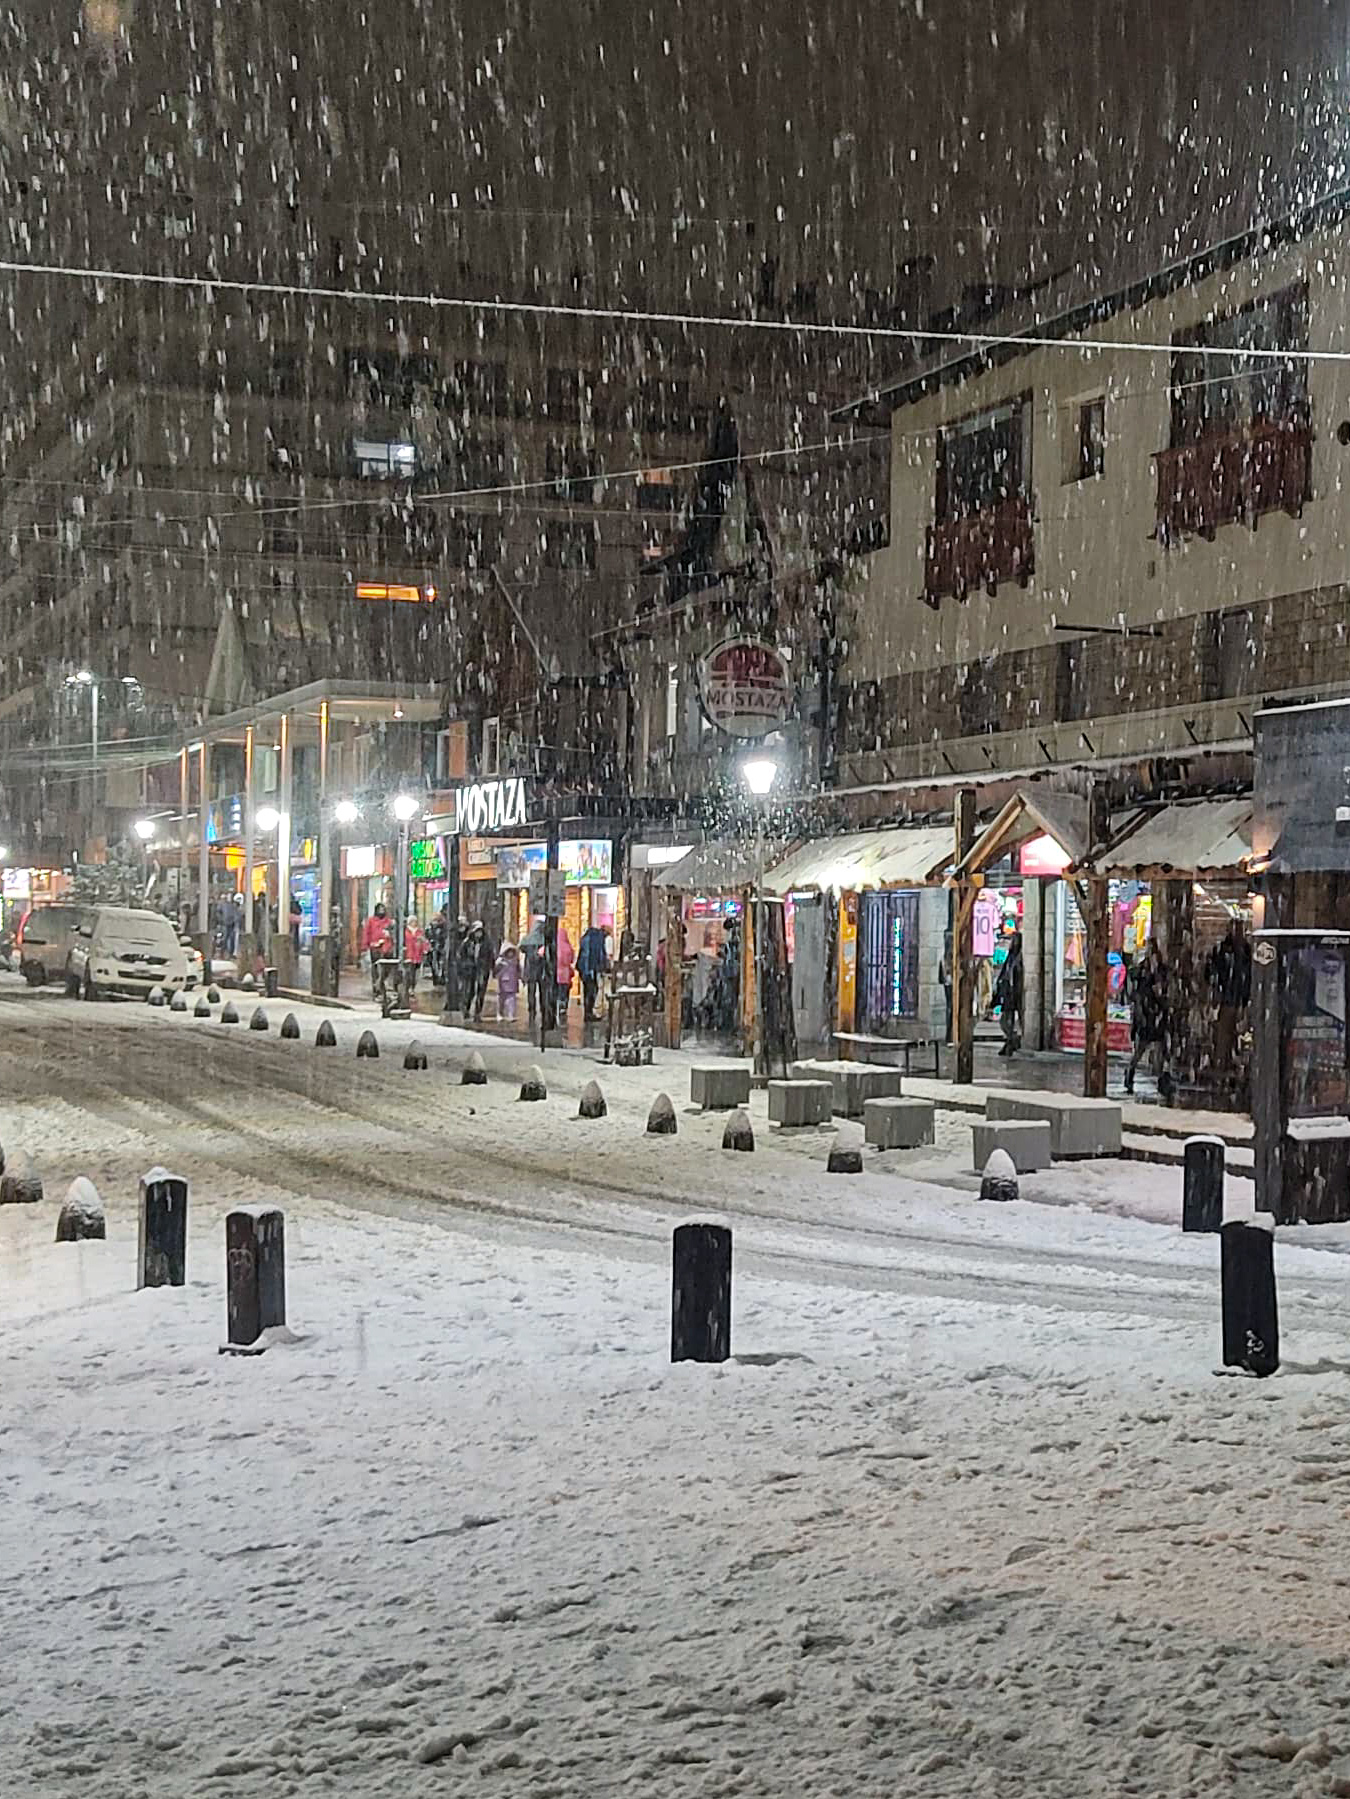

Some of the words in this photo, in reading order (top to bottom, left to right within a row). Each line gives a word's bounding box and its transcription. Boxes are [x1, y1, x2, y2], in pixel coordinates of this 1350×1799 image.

[706, 688, 788, 710] MOSTAZA
[455, 777, 527, 832] MOSTAZA
[974, 915, 990, 936] 10
